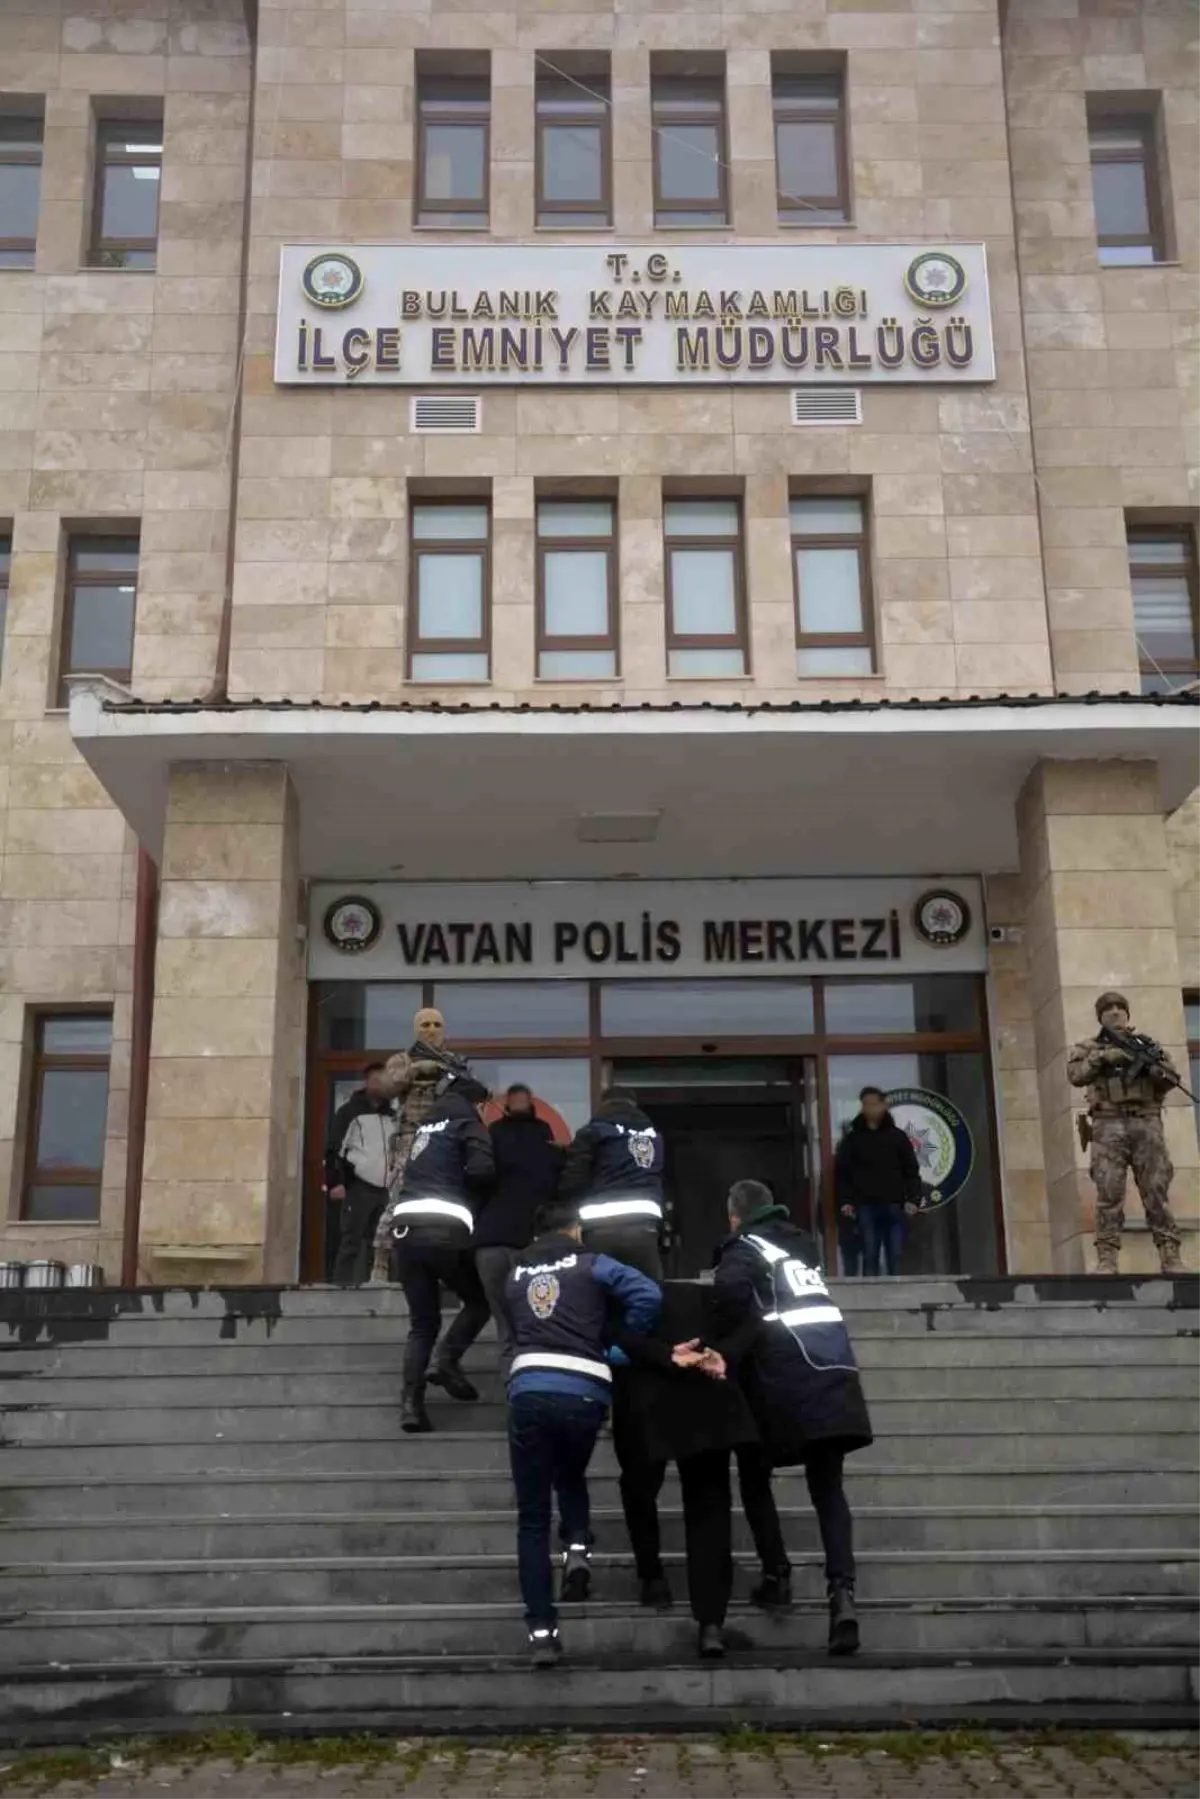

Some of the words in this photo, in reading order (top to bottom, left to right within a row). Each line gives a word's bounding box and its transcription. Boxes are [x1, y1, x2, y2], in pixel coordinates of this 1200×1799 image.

[606, 252, 682, 283] T.C.
[400, 290, 558, 320] BULANIK
[589, 285, 868, 320] KAYMAKAMLIĞI
[297, 319, 401, 378] İLÇE
[430, 316, 642, 373] EMNİYET
[676, 316, 974, 371] MÜDÜRLÜĞÜ
[397, 922, 533, 966] VATAN
[554, 911, 682, 963] POLİS
[702, 909, 901, 962] MERKEZİ
